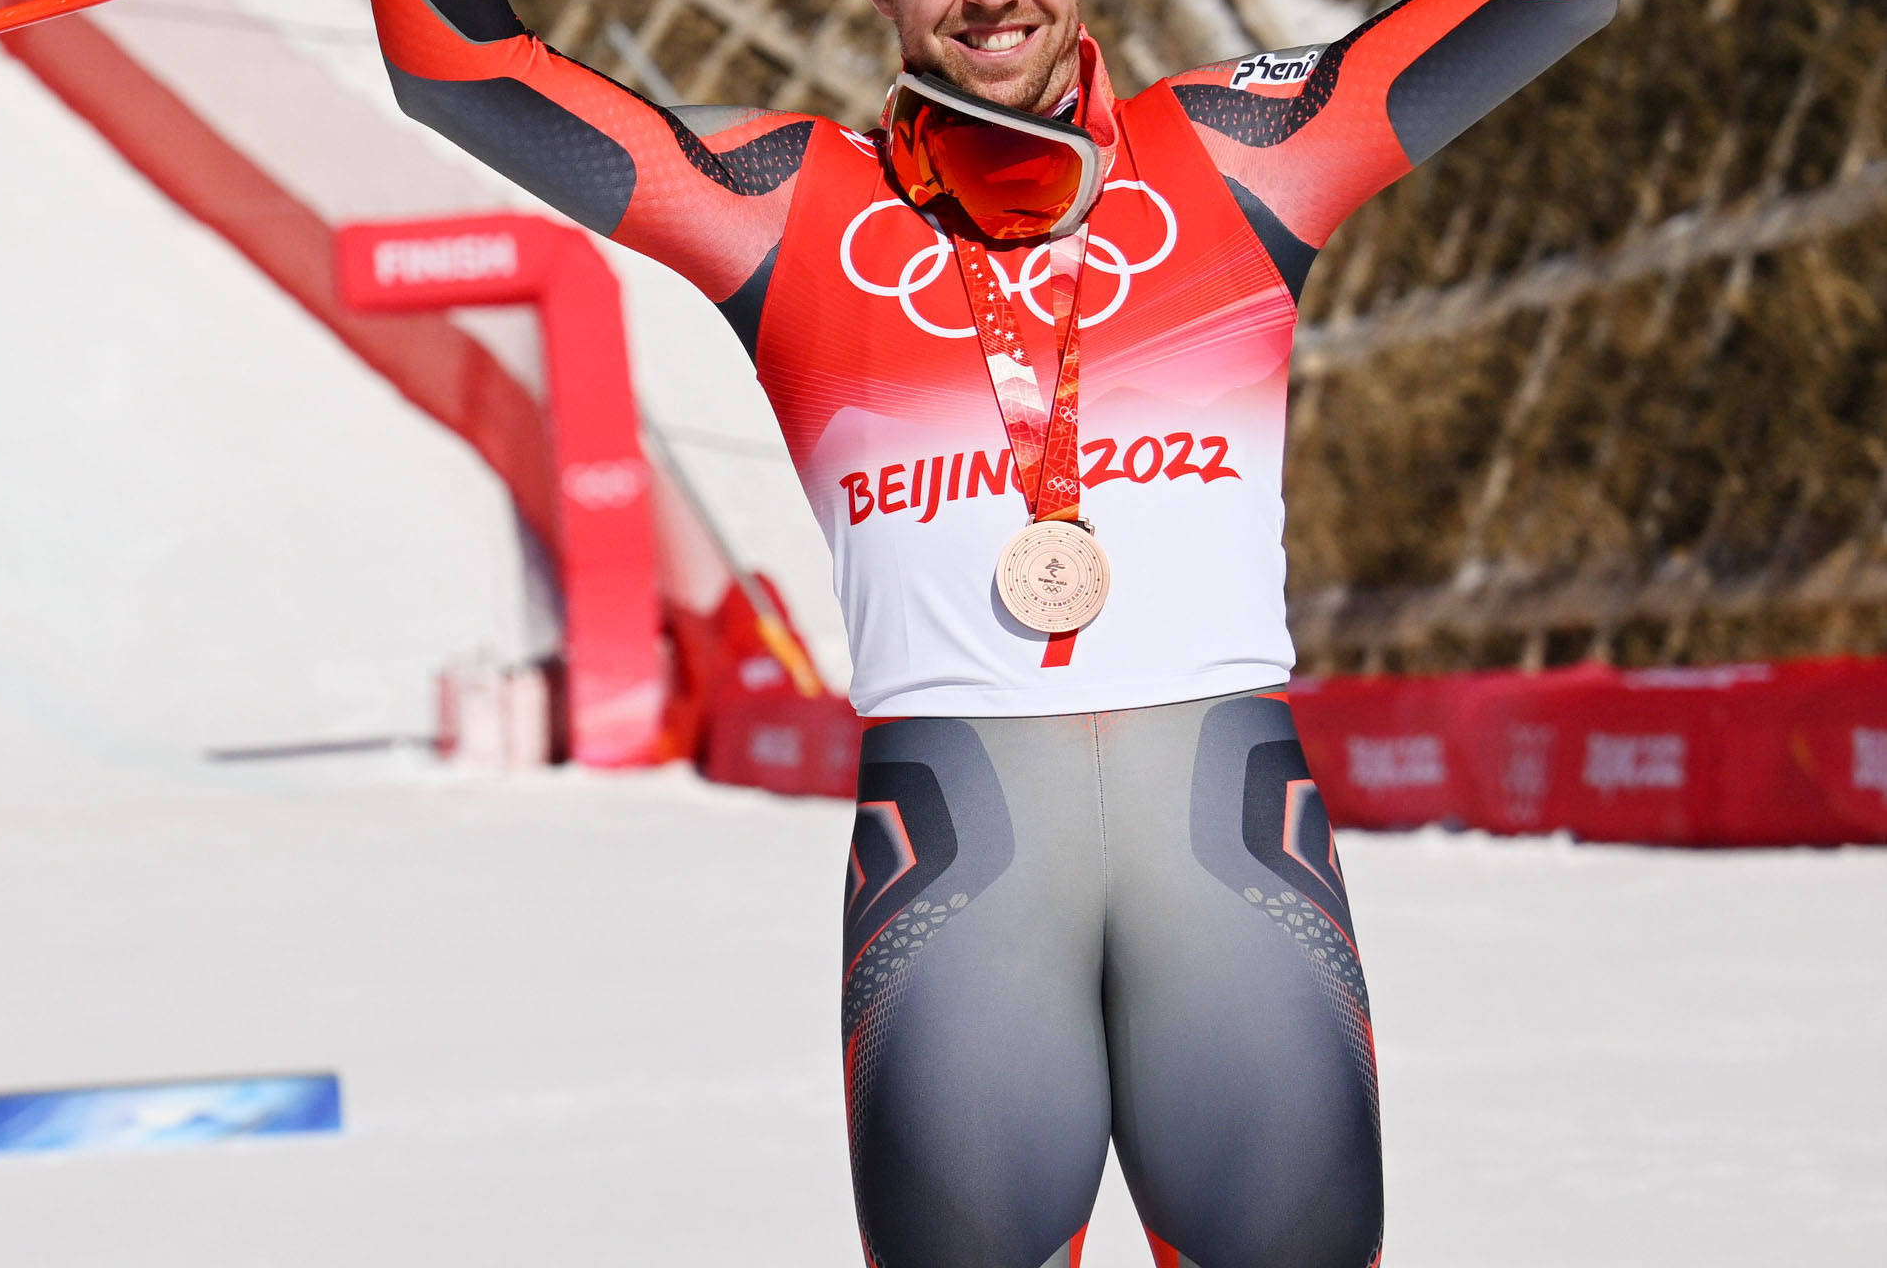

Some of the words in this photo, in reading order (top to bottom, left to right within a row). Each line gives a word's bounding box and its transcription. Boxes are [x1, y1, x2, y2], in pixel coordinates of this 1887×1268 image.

[1232, 52, 1316, 86] pheni
[373, 232, 518, 285] FINISH
[839, 447, 1023, 526] BEIJIN
[1080, 431, 1244, 490] 2022
